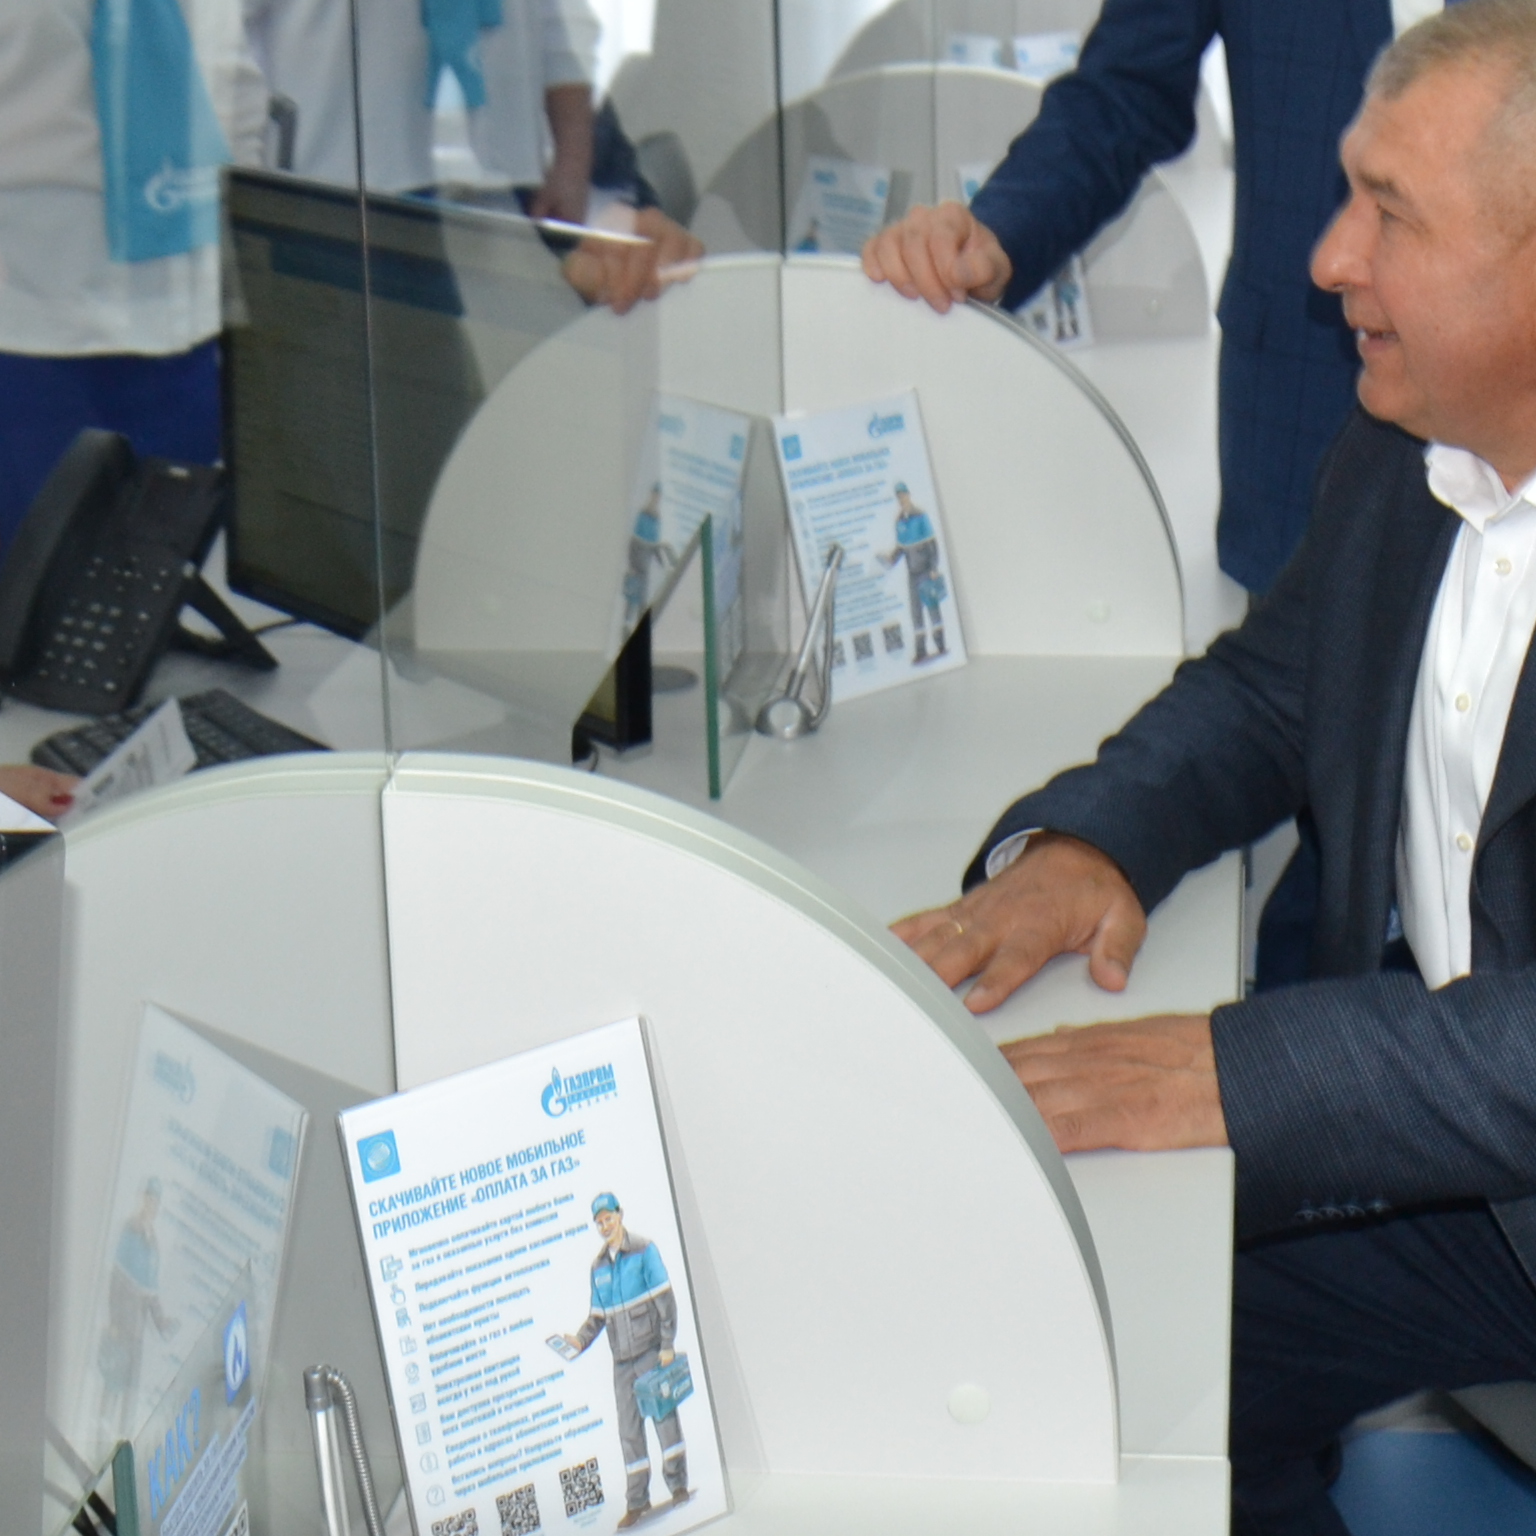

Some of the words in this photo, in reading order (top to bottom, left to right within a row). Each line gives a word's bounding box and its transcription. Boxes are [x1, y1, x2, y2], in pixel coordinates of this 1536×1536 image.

[564, 1064, 614, 1093] ГАЗПРОМ
[369, 1175, 457, 1218] СКАЧИВАЙТЕ
[460, 1159, 504, 1187] НОВОЕ
[506, 1130, 586, 1171] МОБИЛЬНОЕ
[373, 1194, 468, 1240] ПРИЛОЖЕНИЕ
[472, 1174, 529, 1204] «ОПЛАТА
[531, 1166, 548, 1185] ЗА
[550, 1157, 581, 1178] ГАЗ»
[148, 1386, 202, 1521] КАК?
